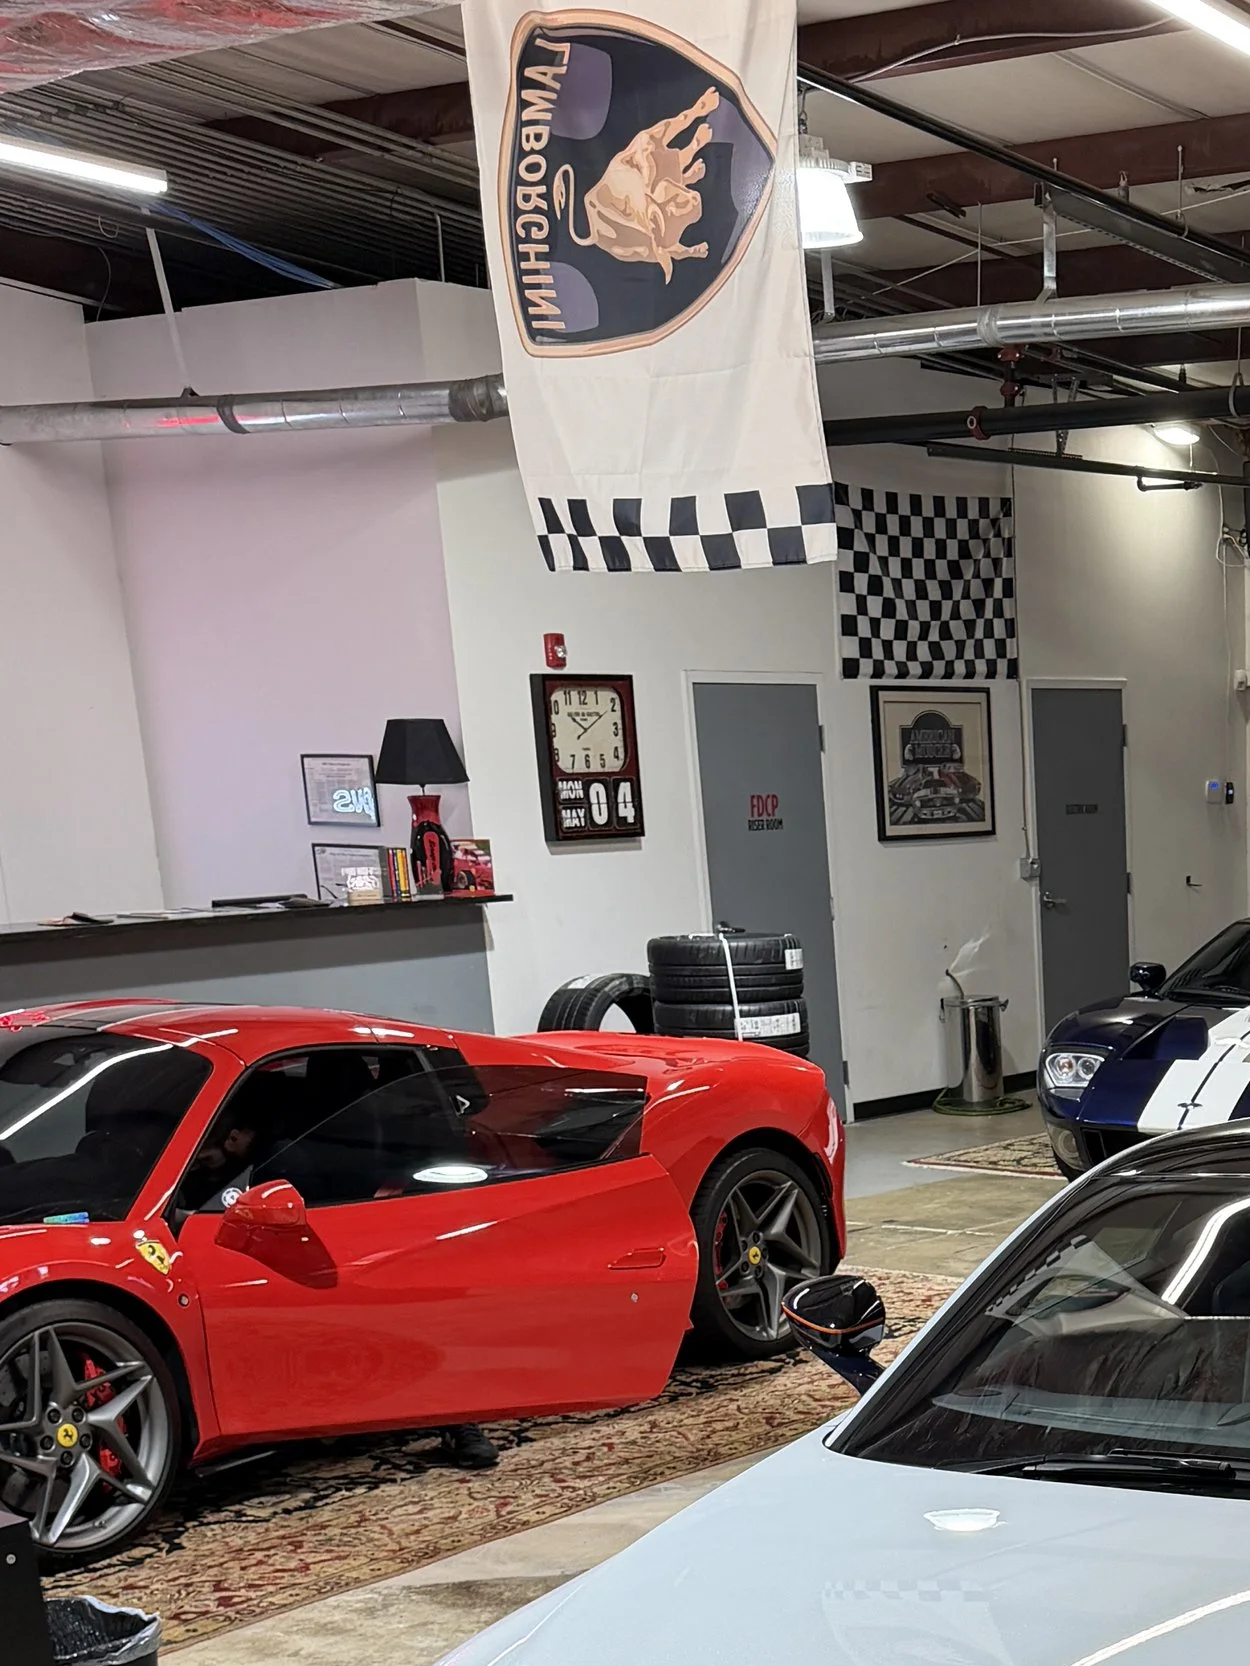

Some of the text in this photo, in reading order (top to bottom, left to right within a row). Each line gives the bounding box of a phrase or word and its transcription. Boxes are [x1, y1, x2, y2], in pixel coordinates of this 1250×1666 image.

[563, 690, 572, 706] 11
[577, 690, 588, 706] 12
[593, 690, 599, 705] 1
[610, 697, 617, 713] 2
[612, 721, 619, 737] 3
[569, 754, 576, 770] 7
[584, 754, 591, 770] 6
[600, 753, 606, 769] 5
[613, 746, 620, 762] 4
[558, 780, 584, 799] MON
[750, 793, 779, 818] FDCP
[561, 808, 586, 828] MAY
